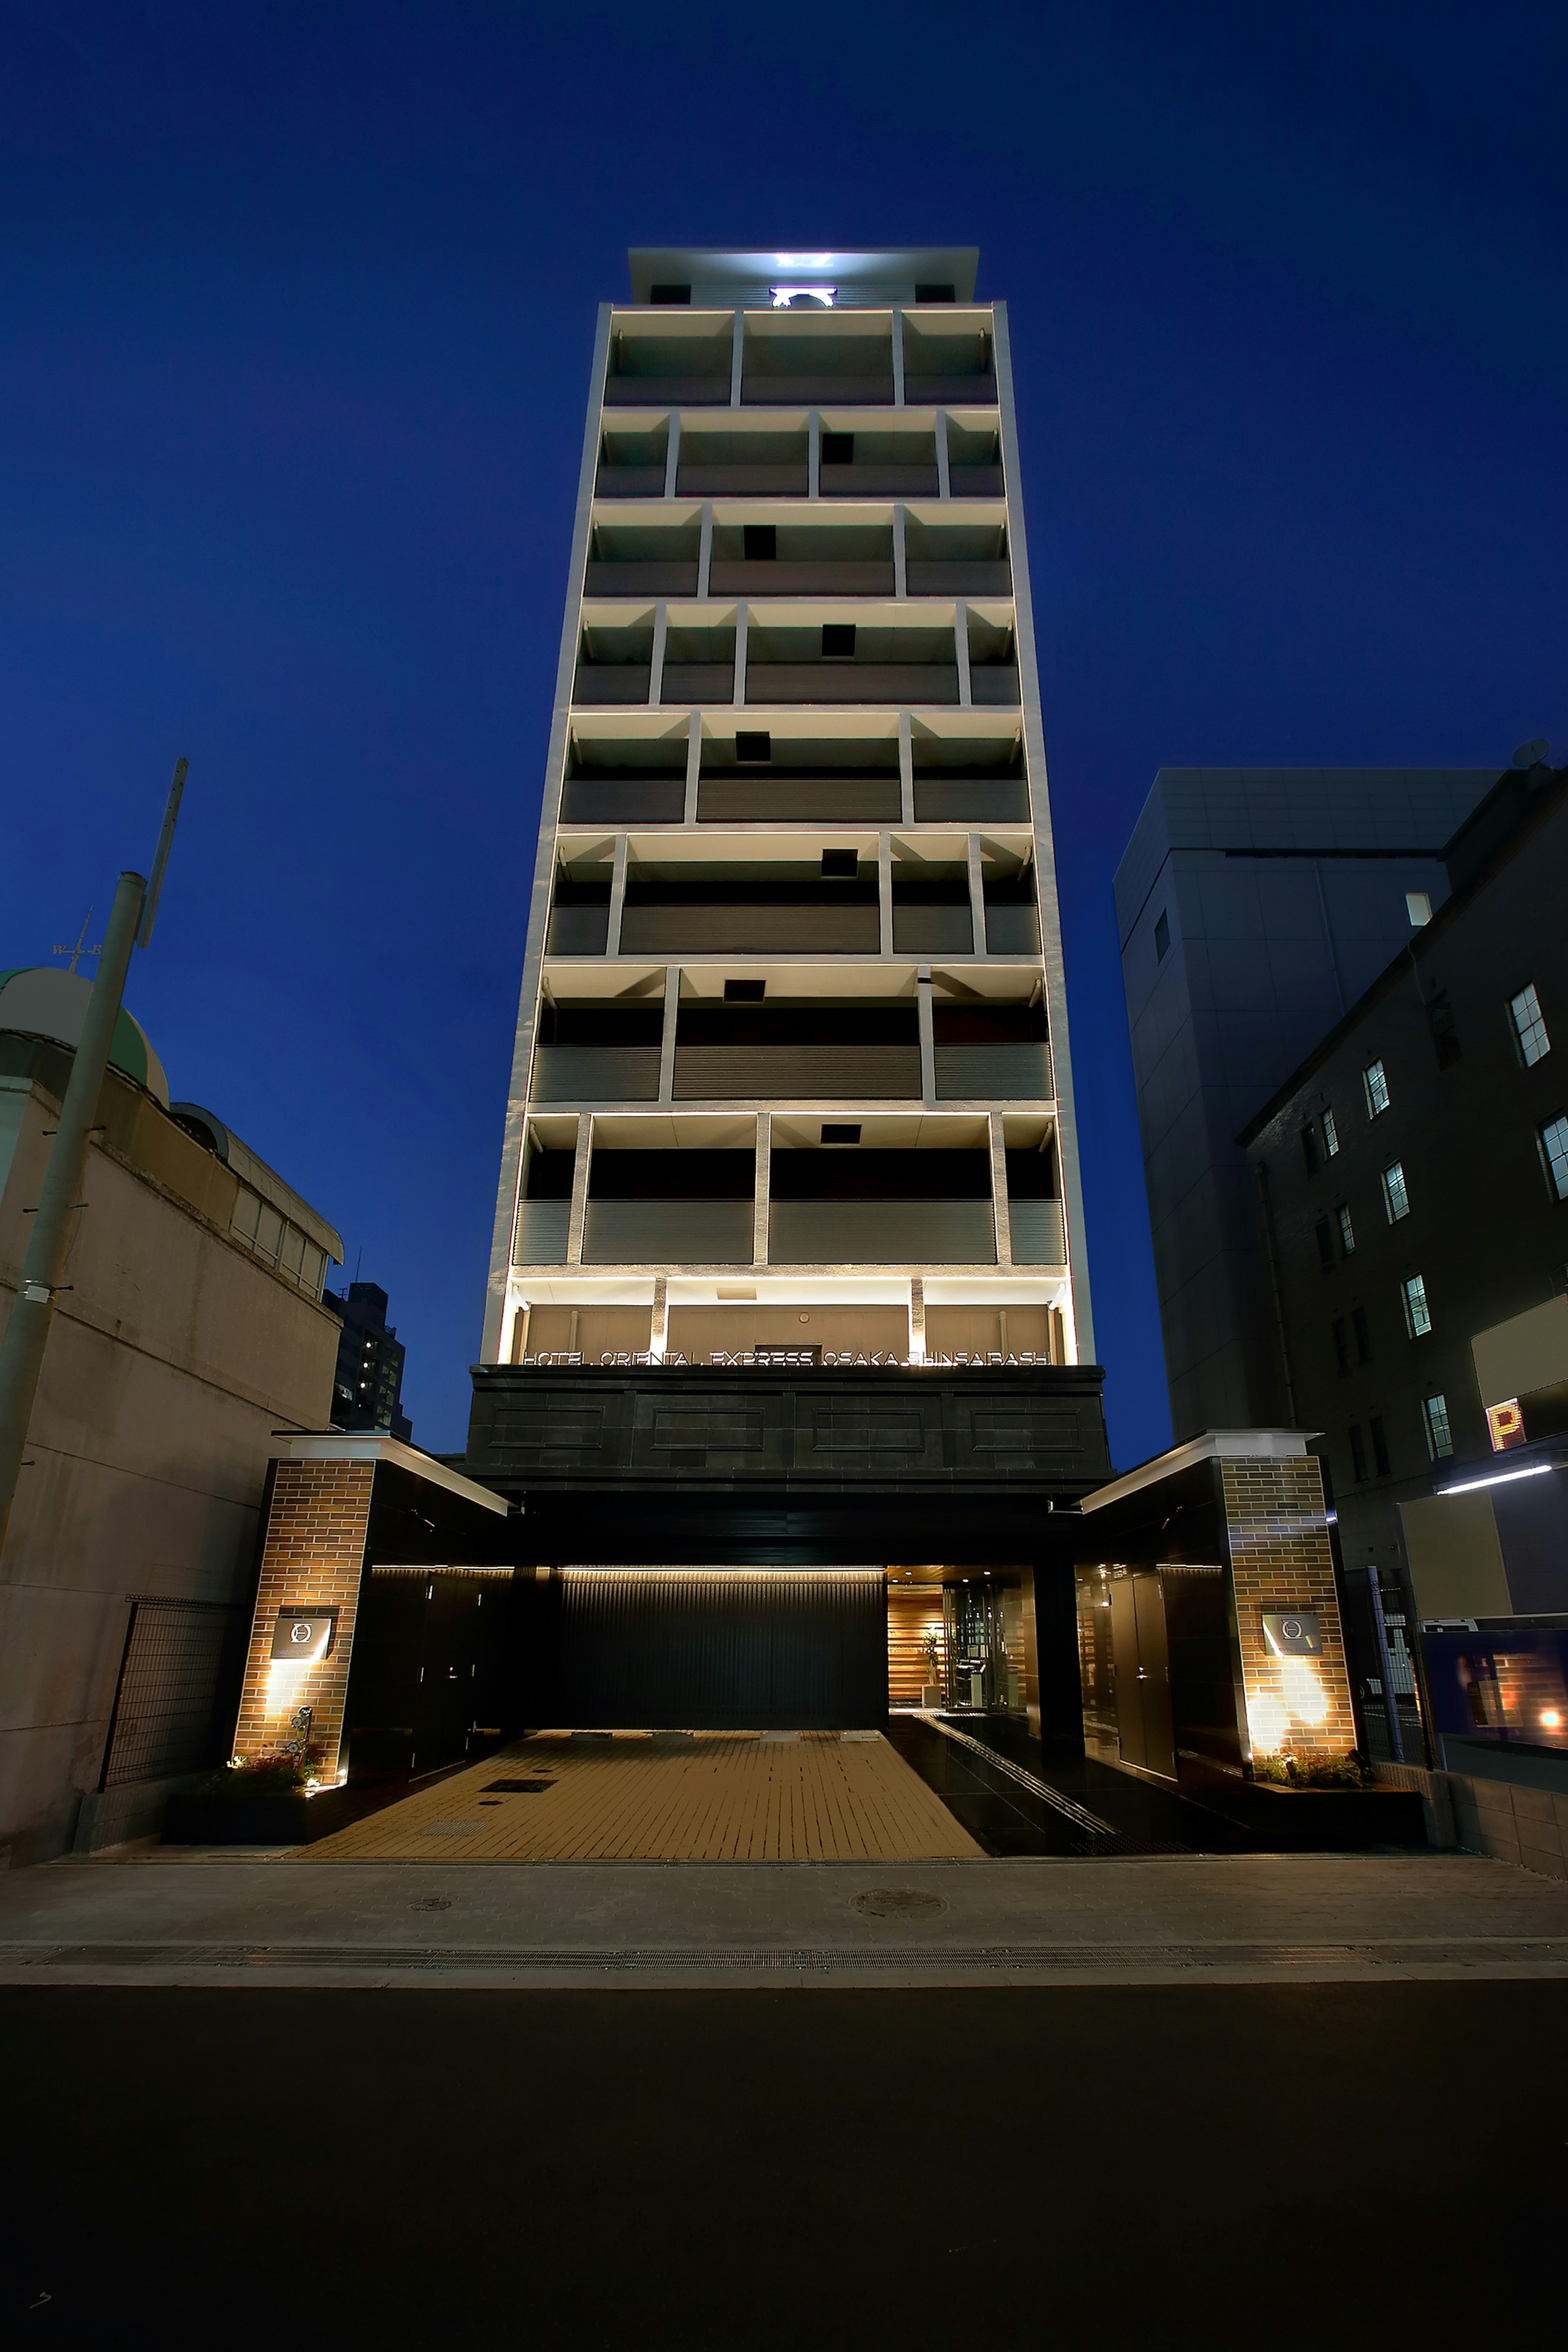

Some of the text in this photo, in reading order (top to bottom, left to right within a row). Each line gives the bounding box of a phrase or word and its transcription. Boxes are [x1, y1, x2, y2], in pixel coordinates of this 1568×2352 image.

[53, 945, 67, 955] W
[524, 1351, 595, 1366] HOTEL
[599, 1351, 704, 1366] ORIENTAL
[709, 1351, 814, 1366] EXPRESS
[823, 1351, 900, 1366] OSAKA
[1489, 1403, 1522, 1451] P
